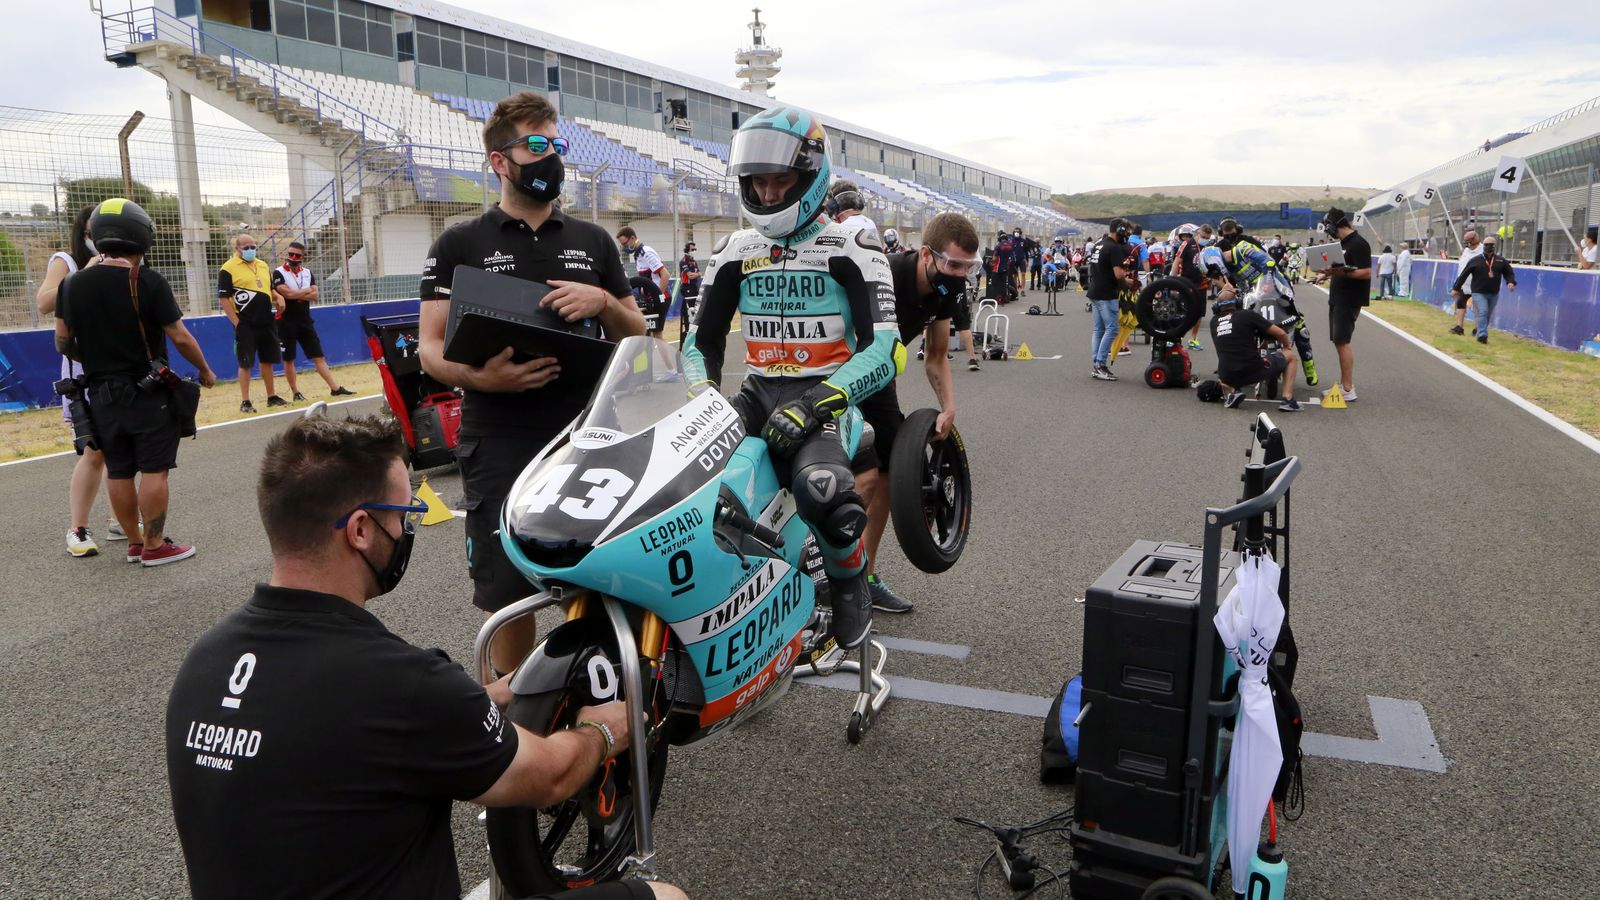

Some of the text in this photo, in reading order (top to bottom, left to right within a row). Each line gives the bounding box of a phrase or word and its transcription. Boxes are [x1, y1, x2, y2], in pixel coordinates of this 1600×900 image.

[1500, 166, 1518, 184] 4
[1394, 193, 1404, 203] 6
[1424, 188, 1434, 200] 5
[794, 223, 820, 243] LEOPARD
[483, 253, 514, 262] ANONIMO
[563, 249, 587, 257] LEOPARD
[564, 262, 592, 271] IMPALA
[743, 257, 770, 271] RACC
[747, 275, 826, 298] LEOPARD
[760, 301, 807, 311] NATURAL
[1260, 305, 1275, 321] 11
[749, 319, 828, 339] IMPALA
[758, 346, 788, 363] galp
[1018, 350, 1027, 358] 38
[766, 363, 801, 374] RACC
[1330, 394, 1340, 402] 11
[669, 398, 724, 453] ANONIMO
[696, 421, 723, 448] WATCHES
[698, 421, 747, 472] DOVIT
[516, 463, 635, 520] 43
[639, 506, 704, 554] LEOPARD
[660, 533, 697, 556] NATURAL
[729, 558, 764, 593] HONDA
[699, 562, 775, 635] IMPALA
[705, 570, 802, 678] LEOPARD
[732, 633, 785, 688] NATURAL
[735, 672, 770, 710] galp
[185, 720, 262, 759] LEOPARD
[195, 753, 233, 771] NATURAL
